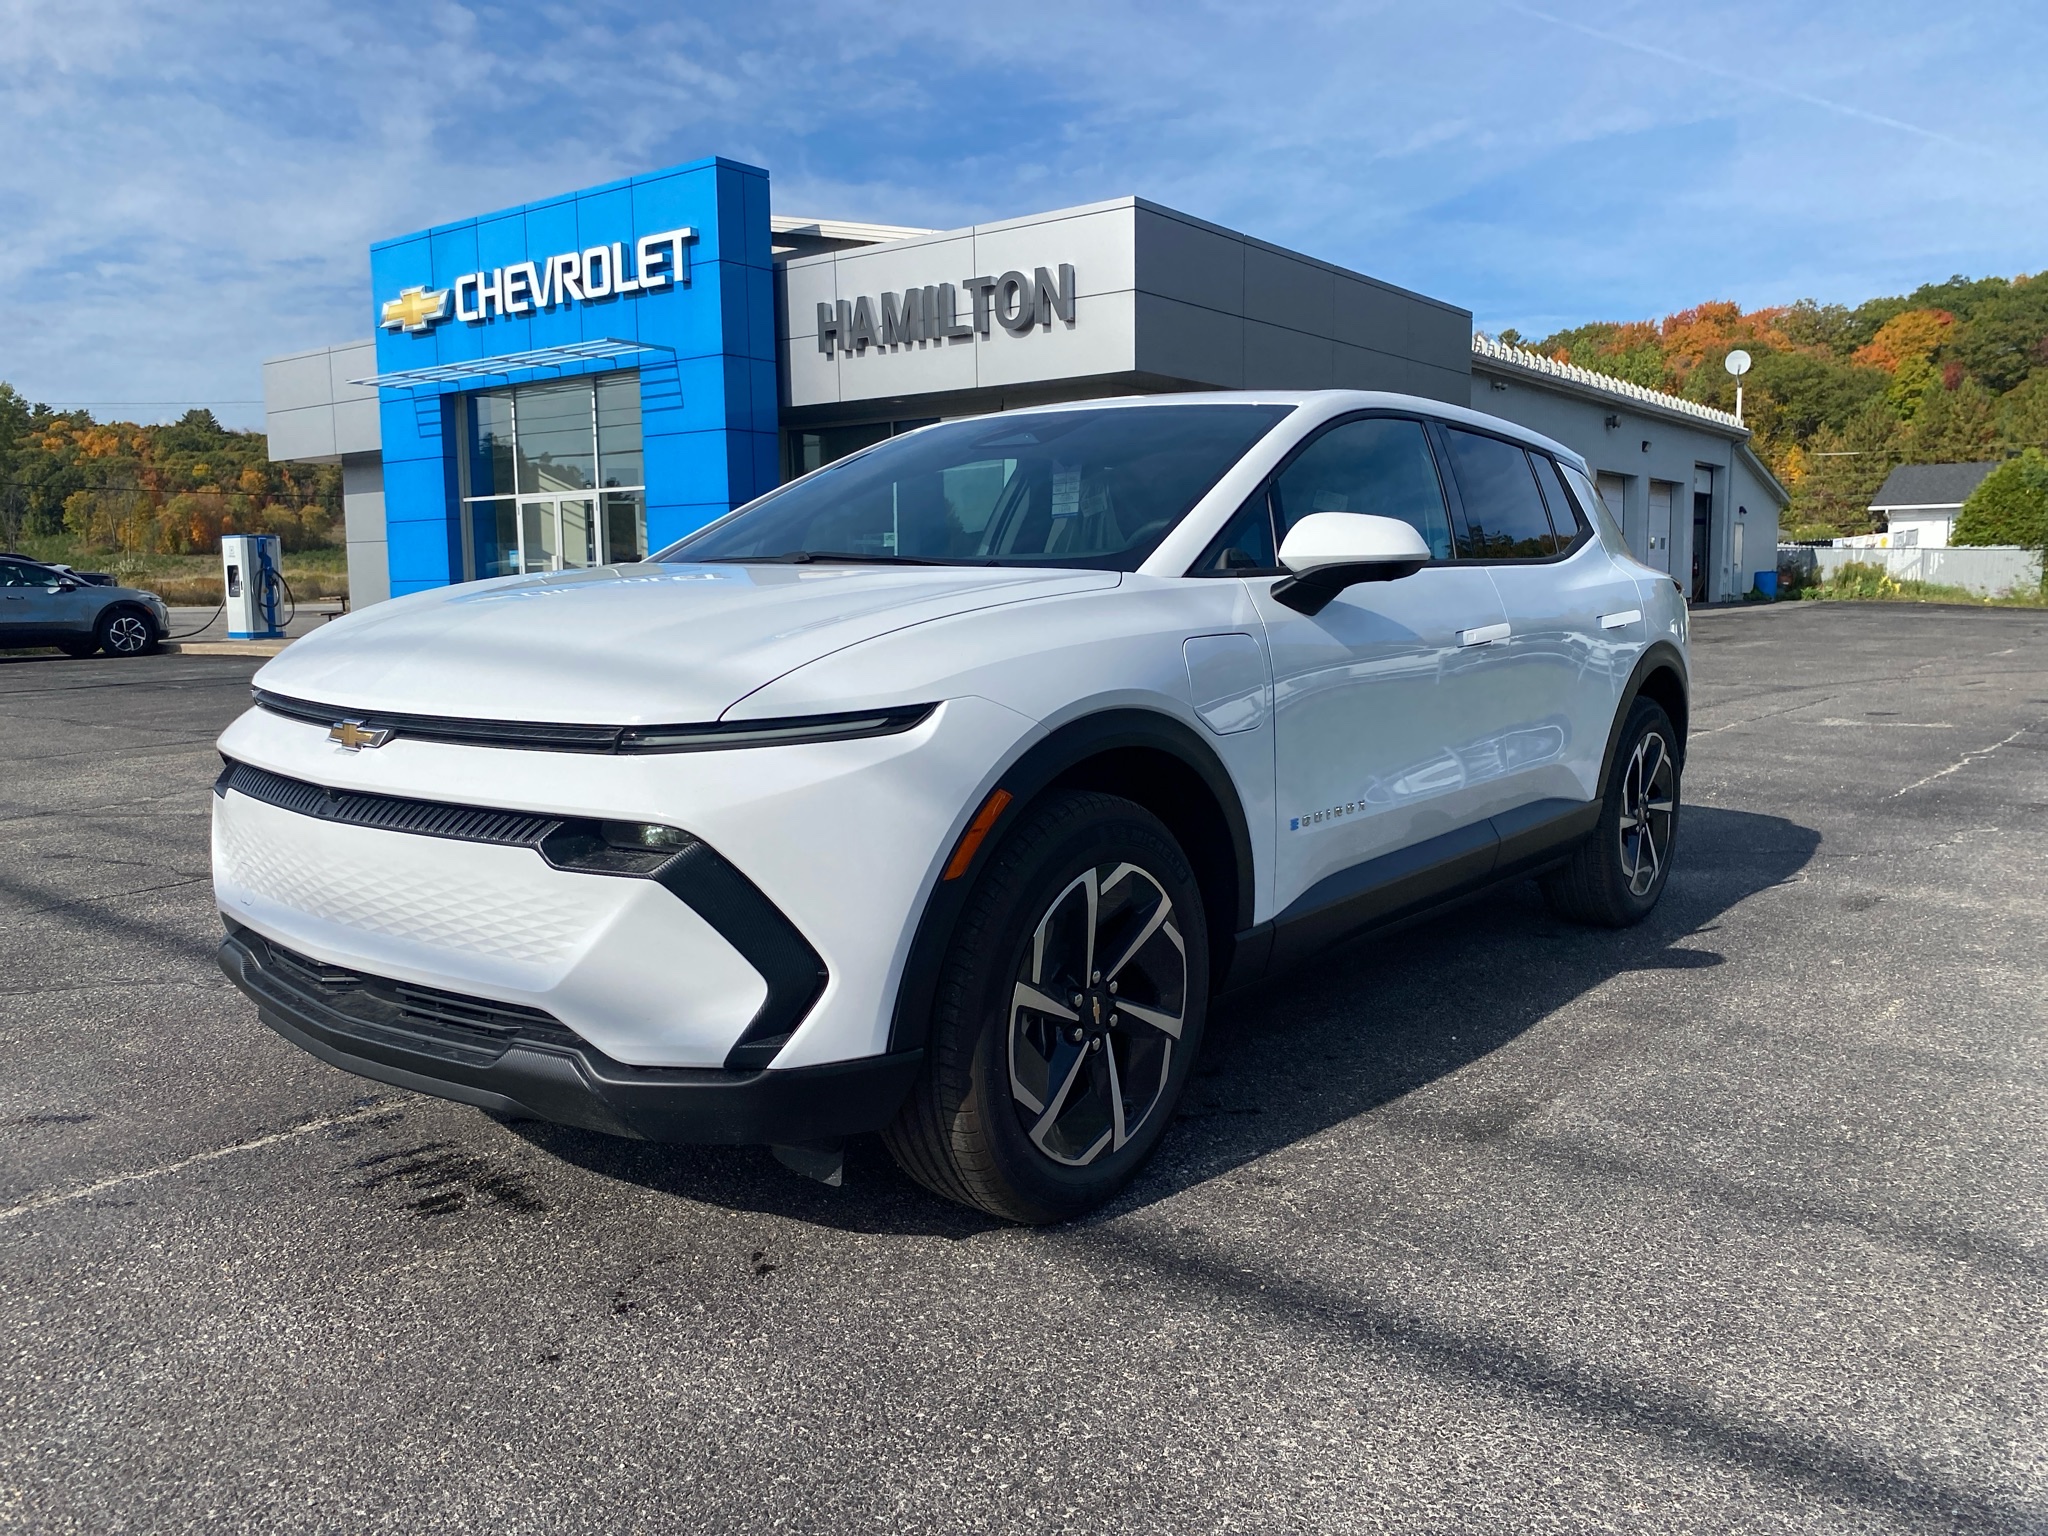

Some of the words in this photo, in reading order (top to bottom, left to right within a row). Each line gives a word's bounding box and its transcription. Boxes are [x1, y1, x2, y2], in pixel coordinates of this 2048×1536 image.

[455, 227, 696, 323] CHEVROLET
[817, 263, 1075, 354] HAMILTON
[1289, 800, 1366, 831] EQUINOX
